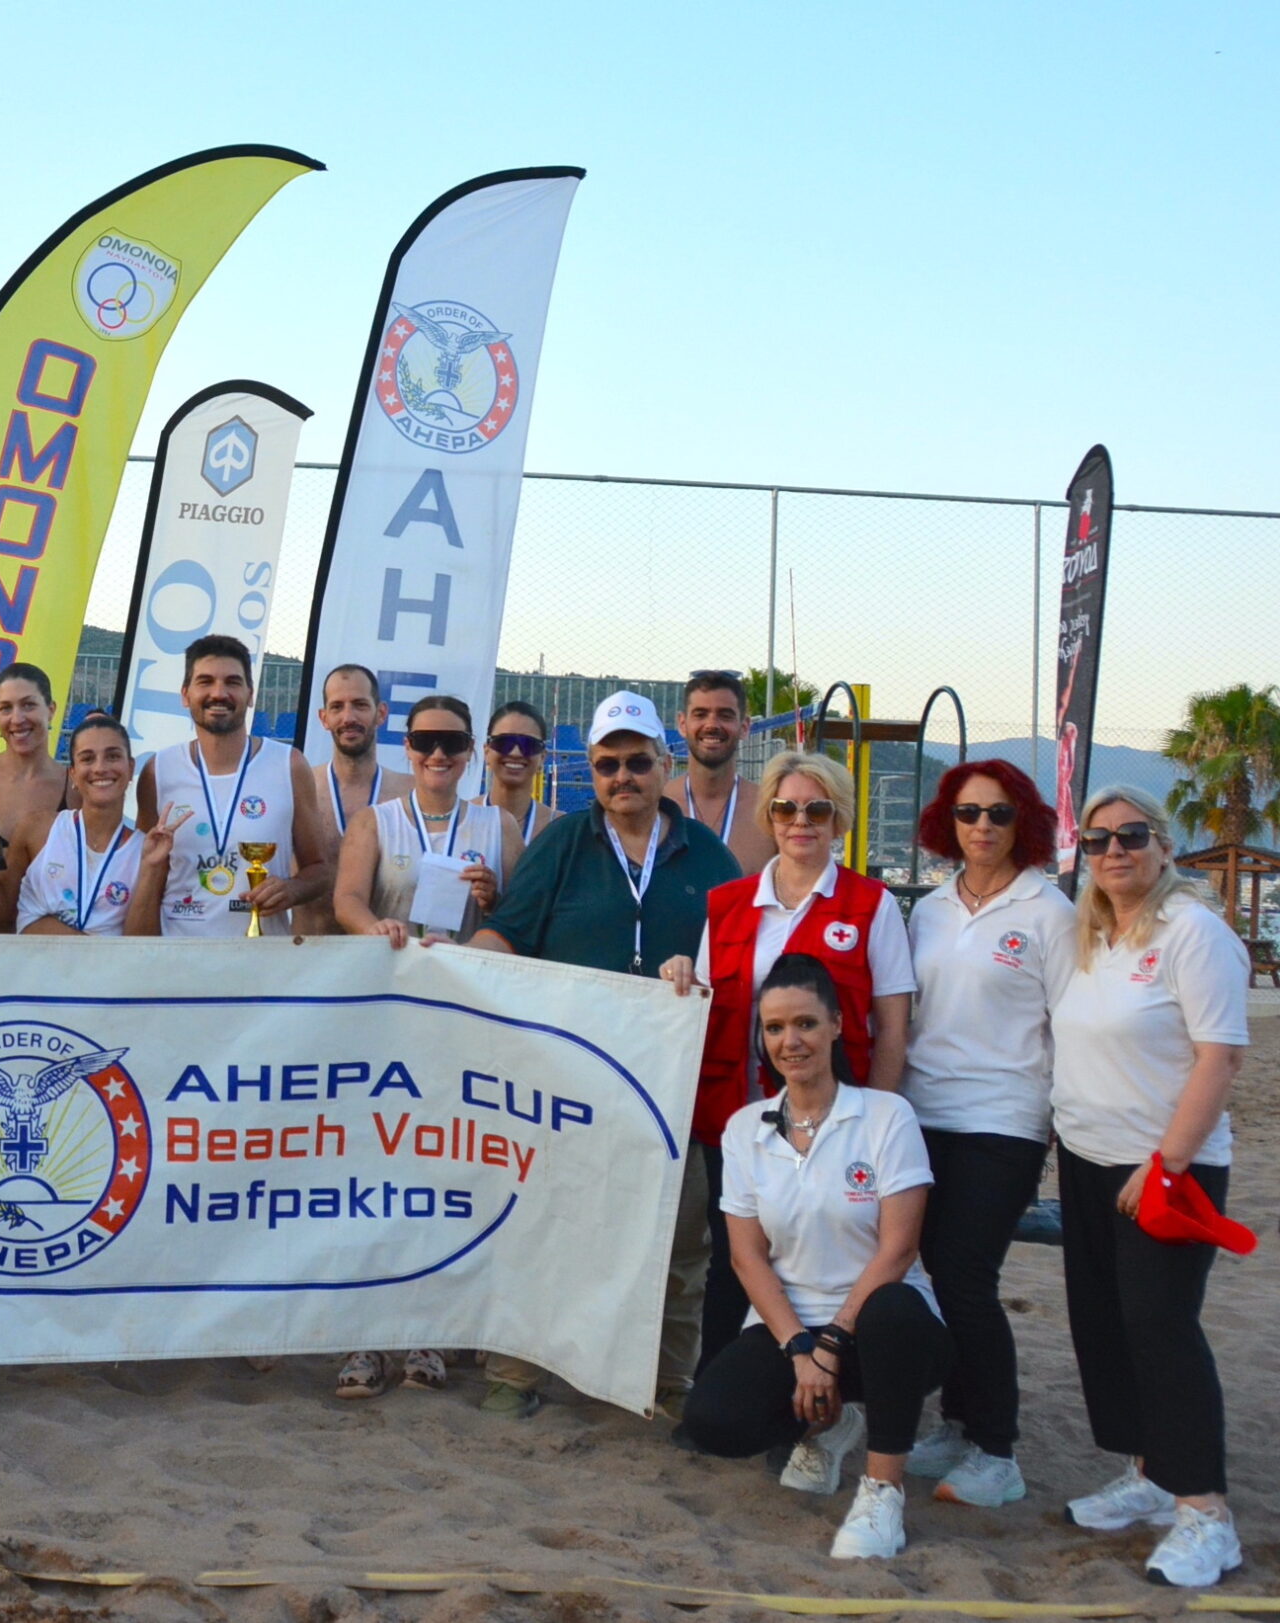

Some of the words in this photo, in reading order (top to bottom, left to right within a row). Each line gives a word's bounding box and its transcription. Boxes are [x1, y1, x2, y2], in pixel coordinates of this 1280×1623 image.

[426, 307, 468, 320] ORDER
[469, 316, 483, 328] OF
[397, 416, 484, 449] AHEPA
[179, 502, 265, 525] PIAGGIO
[47, 1036, 74, 1056] OF
[165, 1061, 423, 1102] AHEPA
[462, 1070, 594, 1132] CUP
[166, 1114, 346, 1162] Beach
[372, 1112, 536, 1183] Volley
[165, 1177, 473, 1229] Nafpaktos
